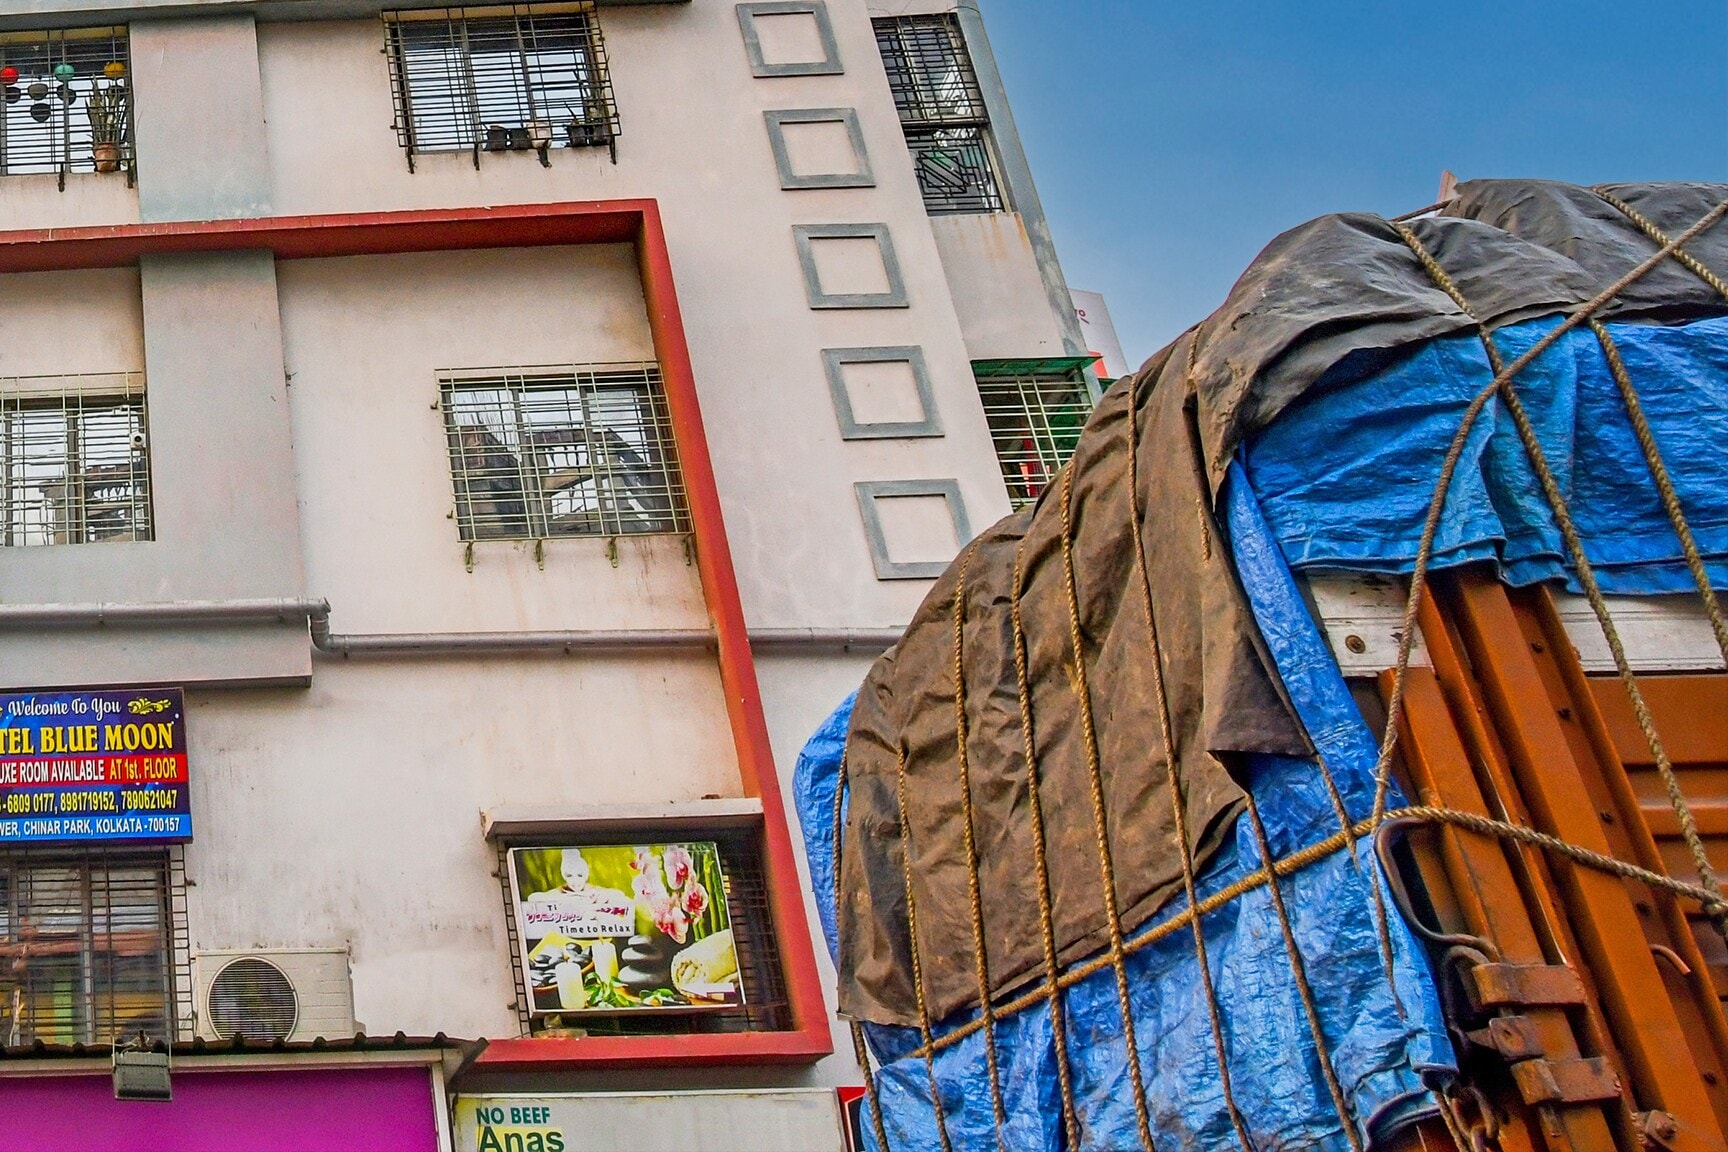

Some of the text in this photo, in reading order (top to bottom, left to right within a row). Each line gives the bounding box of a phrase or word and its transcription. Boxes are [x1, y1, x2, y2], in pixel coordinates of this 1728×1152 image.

[8, 697, 121, 721] Welcome To You
[40, 725, 98, 753] BLUE
[105, 723, 172, 751] MOON
[20, 761, 49, 783] ROOM
[51, 759, 104, 782] AVAILABLE
[110, 759, 122, 779] AT
[125, 758, 141, 779] 1st.
[144, 757, 177, 779] FLOOR
[121, 790, 177, 810] 7890621047
[23, 820, 60, 835] CHINAR
[63, 819, 93, 835] PARK,
[559, 924, 630, 933] Time to Relax
[476, 1107, 551, 1124] NO BEEF
[479, 1126, 565, 1152] Anas
